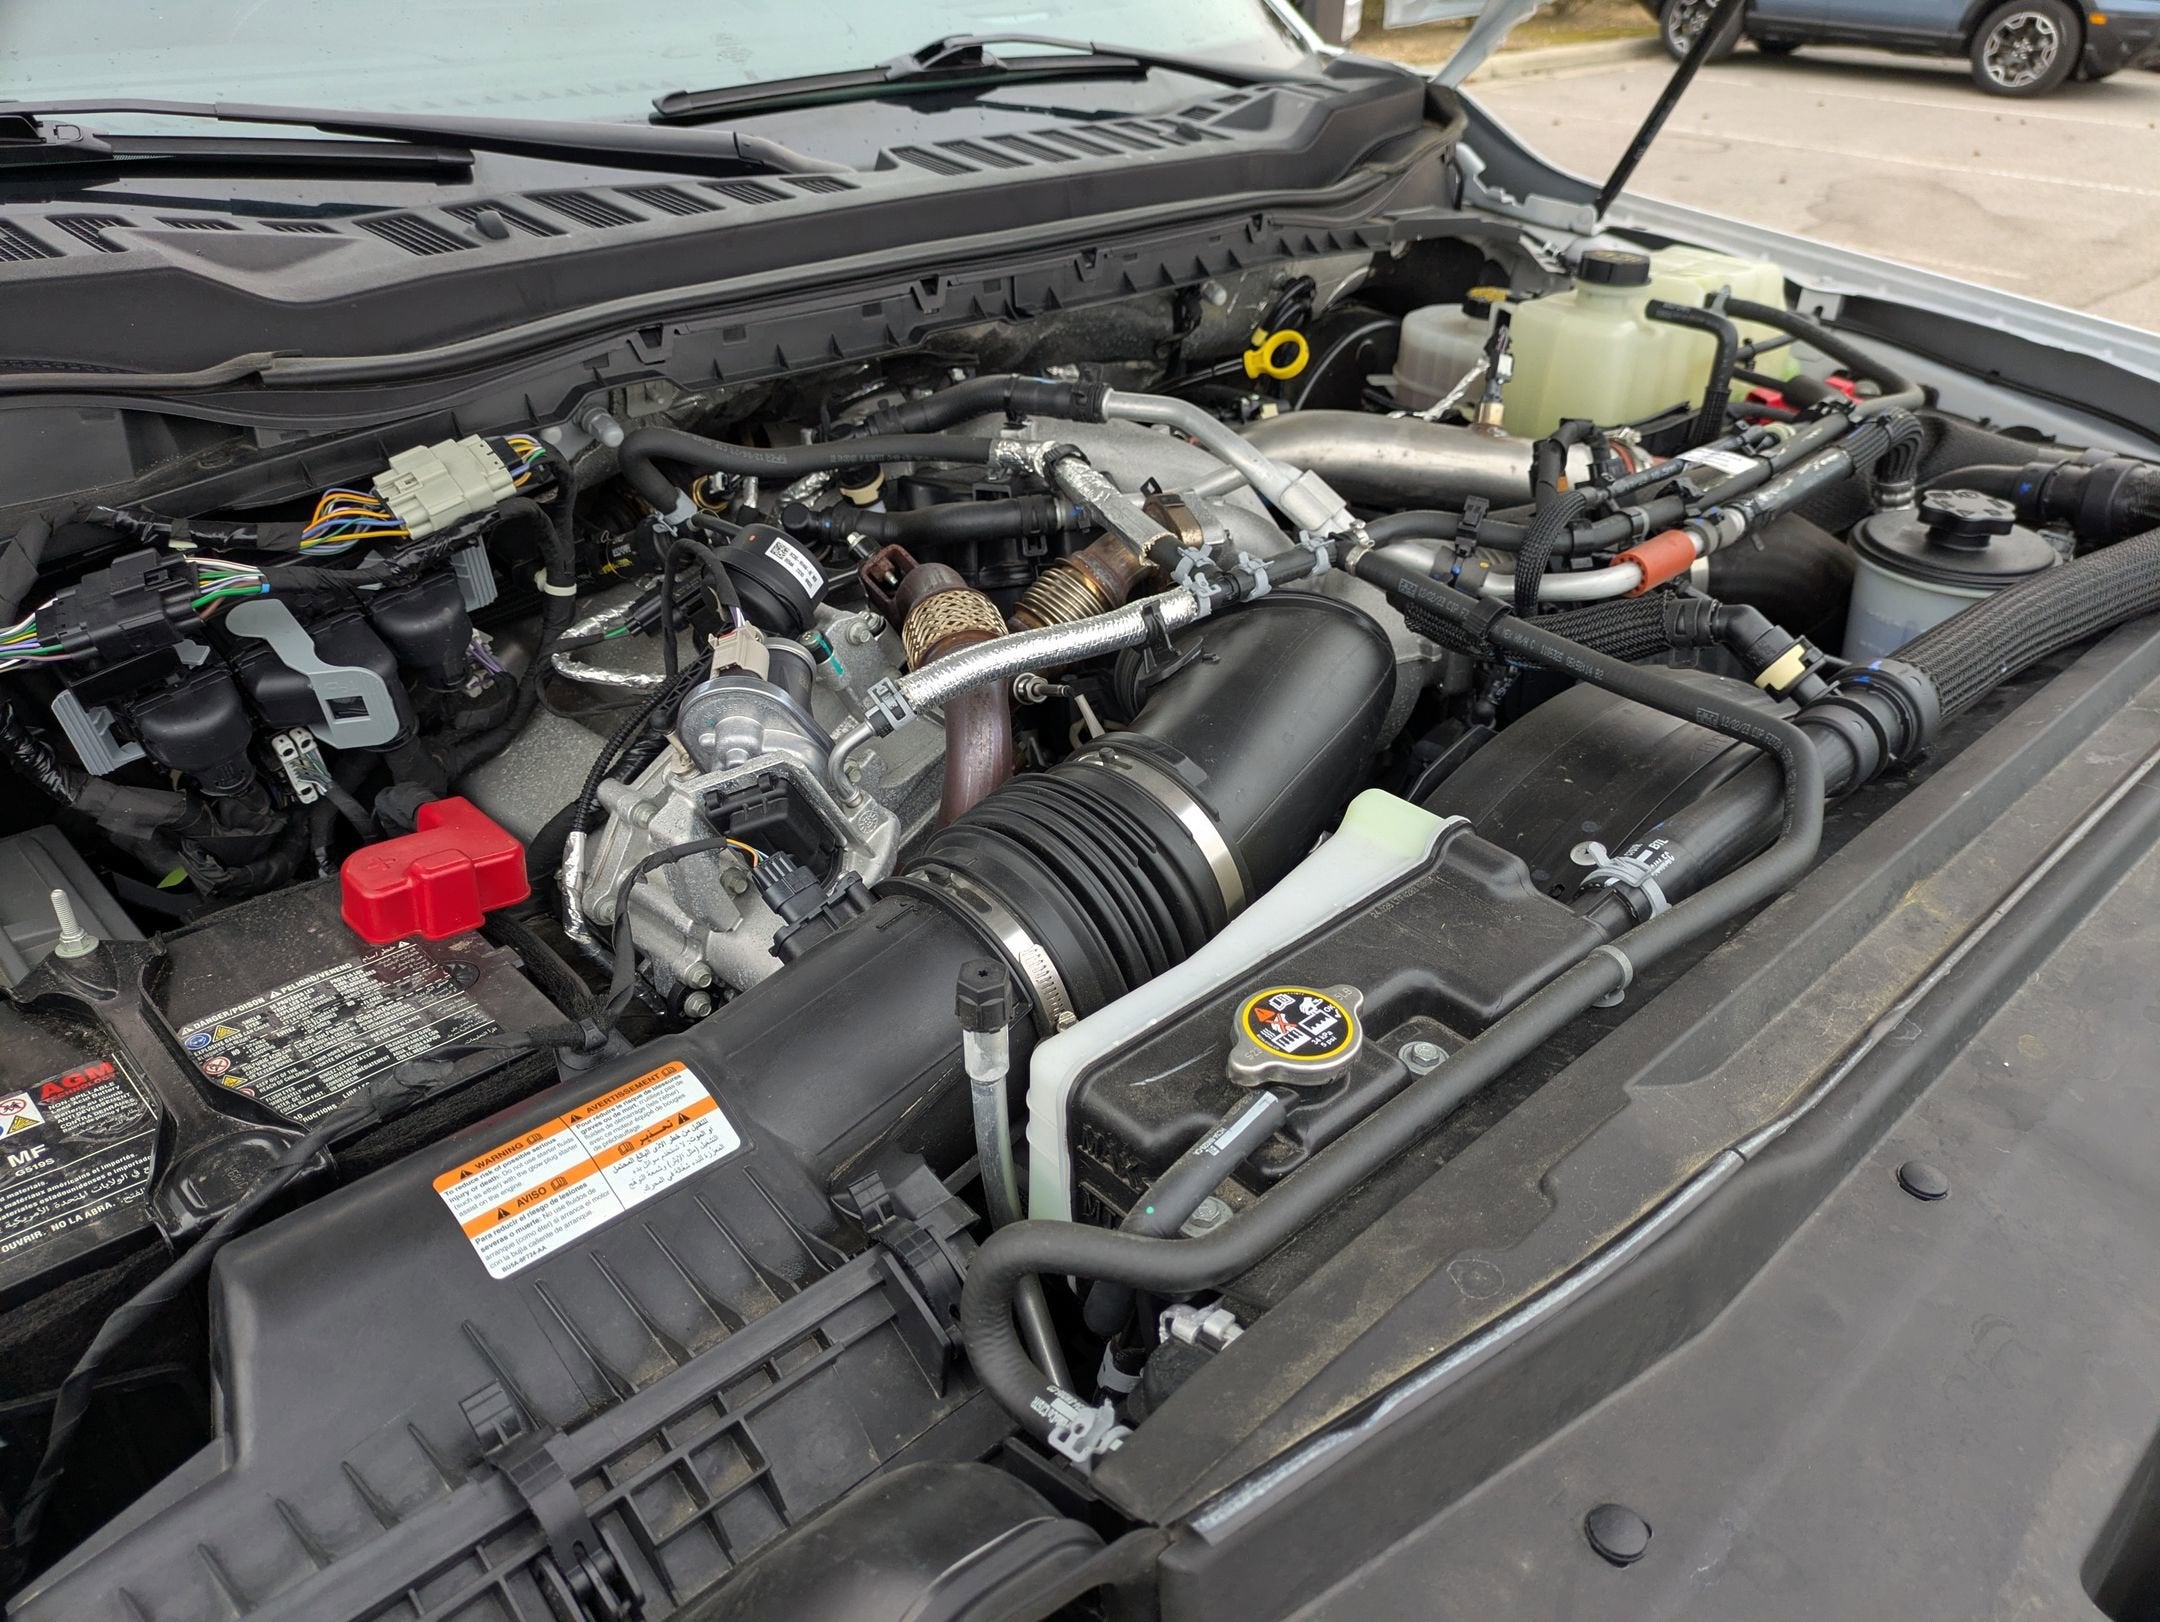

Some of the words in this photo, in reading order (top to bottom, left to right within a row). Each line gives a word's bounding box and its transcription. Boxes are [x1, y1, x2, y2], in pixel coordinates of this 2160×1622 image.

[1648, 838, 1670, 851] BTL
[281, 963, 352, 993] PELIGRO/VENENO
[193, 998, 265, 1029] DANGER/POISON
[1323, 1002, 1336, 1015] OK
[1311, 1035, 1322, 1045] 34
[1320, 1030, 1333, 1040] kPa
[1326, 1035, 1337, 1045] psi
[40, 1061, 115, 1100] AGM
[587, 1073, 659, 1113] AVERTISSEMENT
[48, 1082, 118, 1110] NON-SPILLABLE
[50, 1103, 72, 1115] Lead
[72, 1096, 91, 1106] Acid
[91, 1085, 120, 1099] Battery
[575, 1119, 592, 1130] Pour
[592, 1107, 616, 1121] réduire
[623, 1094, 643, 1106] risque
[651, 1074, 682, 1091] blessures
[580, 1121, 603, 1135] graves
[663, 1084, 676, 1093] pas
[56, 1114, 77, 1124] ANTI
[59, 1114, 95, 1129] CONTRA
[583, 1127, 605, 1140] fluides
[604, 1122, 614, 1130] de
[614, 1106, 646, 1125] démarrage
[589, 1135, 604, 1146] avec
[604, 1130, 613, 1138] ce
[612, 1120, 634, 1133] moteur
[7, 1144, 46, 1167] MF
[475, 1142, 524, 1169] WARNING
[593, 1144, 602, 1152] de
[4, 1190, 45, 1209] matériaux
[47, 1172, 91, 1192] américains
[101, 1153, 137, 1170] importés.
[15, 1158, 55, 1176] G519S
[444, 1189, 455, 1197] To
[454, 1177, 479, 1192] reduce
[479, 1170, 494, 1179] risk
[493, 1164, 502, 1172] of
[502, 1151, 531, 1168] possible
[531, 1138, 557, 1153] serious
[448, 1190, 470, 1203] injury
[470, 1185, 479, 1193] or
[479, 1175, 500, 1188] death:
[501, 1168, 513, 1177] Do
[512, 1162, 524, 1171] not
[524, 1156, 537, 1165] use
[536, 1145, 557, 1159] starter
[556, 1137, 575, 1148] fluids
[453, 1197, 473, 1211] (such
[482, 1182, 503, 1195] ether)
[502, 1175, 517, 1185] with
[516, 1169, 528, 1178] the
[527, 1161, 543, 1173] glow
[543, 1153, 559, 1165] plug
[558, 1144, 578, 1157] starter
[6, 1181, 48, 1199] materials.
[40, 1174, 106, 1204] estadounidenses
[517, 1187, 547, 1208] AVISO
[50, 1220, 67, 1232] NO
[68, 1214, 83, 1225] LA
[85, 1202, 115, 1218] ABRA.
[458, 1203, 479, 1217] assist
[478, 1199, 489, 1207] on
[487, 1193, 500, 1202] the
[474, 1233, 493, 1245] Para
[493, 1219, 518, 1236] reducir
[518, 1213, 527, 1222] el
[526, 1203, 549, 1218] riesgo
[549, 1198, 559, 1206] de
[558, 1183, 588, 1200] lesiones
[480, 1235, 509, 1253] severas
[515, 1217, 541, 1234] muerte:
[541, 1211, 553, 1220] No
[553, 1204, 566, 1214] use
[565, 1193, 588, 1207] fluidos
[587, 1188, 597, 1196] de
[485, 1242, 515, 1261] arranque
[515, 1230, 537, 1245] (como
[552, 1216, 560, 1224] si
[560, 1204, 585, 1220] arranca
[584, 1199, 592, 1207] el
[591, 1190, 610, 1203] motor
[489, 1258, 504, 1269] con
[528, 1231, 554, 1248] caliente
[553, 1226, 564, 1234] de
